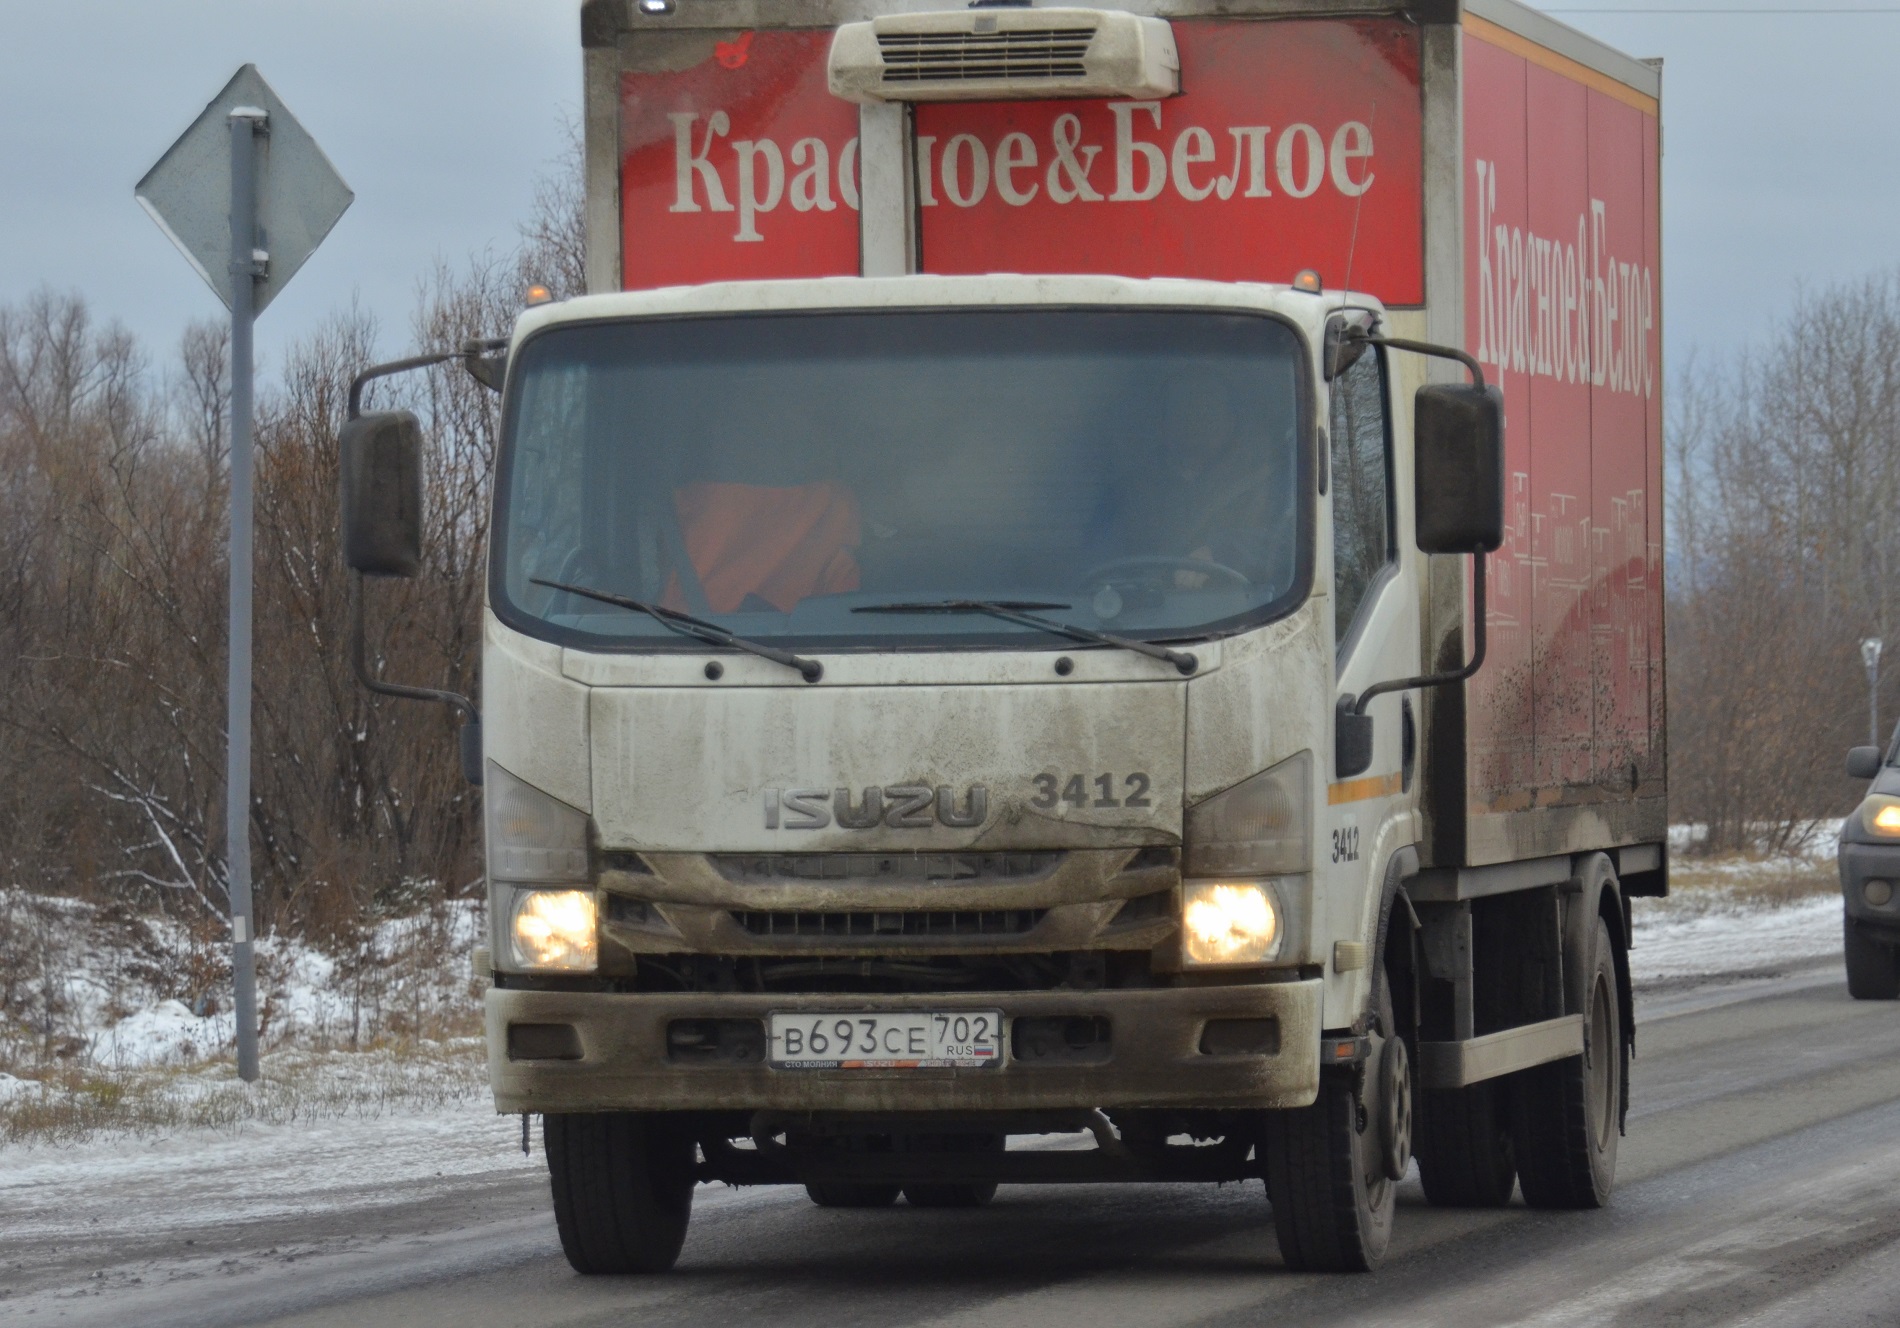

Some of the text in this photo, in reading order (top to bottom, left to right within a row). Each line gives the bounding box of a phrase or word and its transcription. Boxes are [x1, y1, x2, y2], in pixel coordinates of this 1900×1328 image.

[1476, 157, 1653, 428] Красное&Белое
[1031, 771, 1152, 809] 3412
[763, 784, 989, 830] ISUZU
[1332, 826, 1360, 864] 3412
[934, 1016, 990, 1044] 702
[784, 1060, 838, 1069] СТО МОЛНИЯ
[863, 1060, 897, 1069] ISUZU
[946, 1045, 974, 1056] RUS
